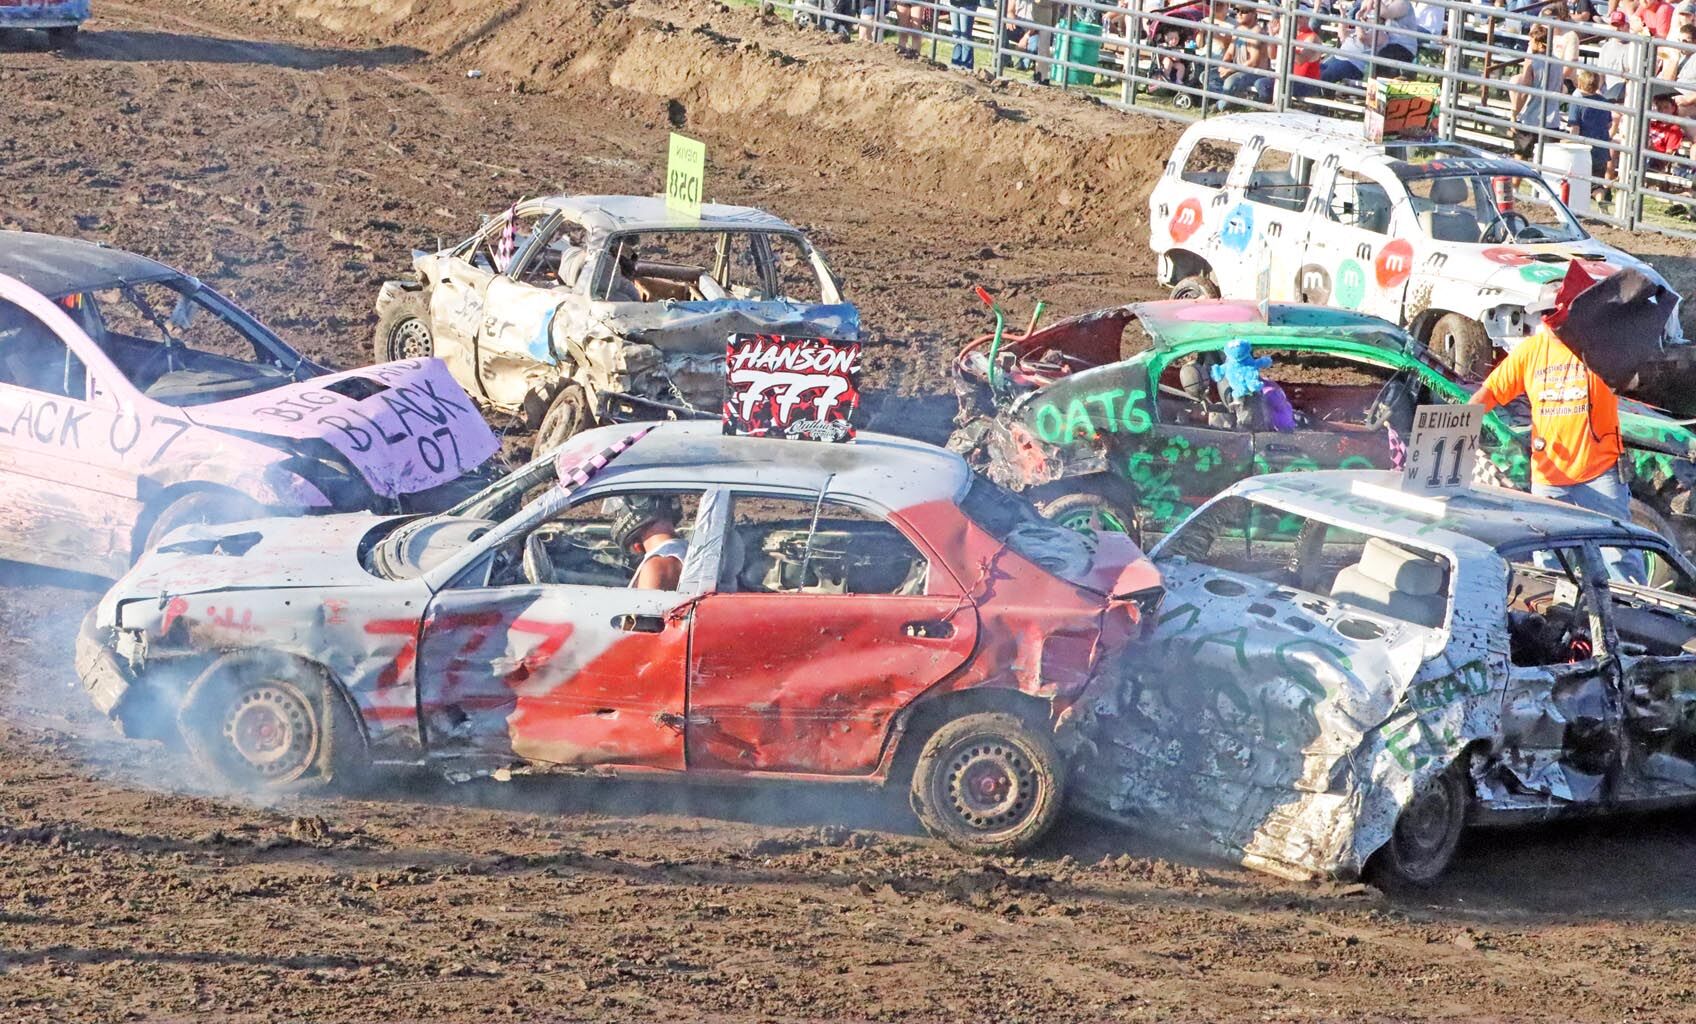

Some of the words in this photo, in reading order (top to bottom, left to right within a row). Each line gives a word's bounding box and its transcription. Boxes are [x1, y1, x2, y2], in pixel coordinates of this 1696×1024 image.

[1384, 97, 1433, 132] 22
[1268, 221, 1282, 239] m
[1356, 242, 1371, 261] m
[1386, 254, 1405, 272] m
[1304, 271, 1324, 289] m
[731, 341, 857, 374] HANSON
[252, 391, 338, 423] BIG
[731, 369, 849, 424] 777
[318, 379, 468, 452] BLACK
[418, 427, 464, 474] 07
[1425, 435, 1468, 488] 11
